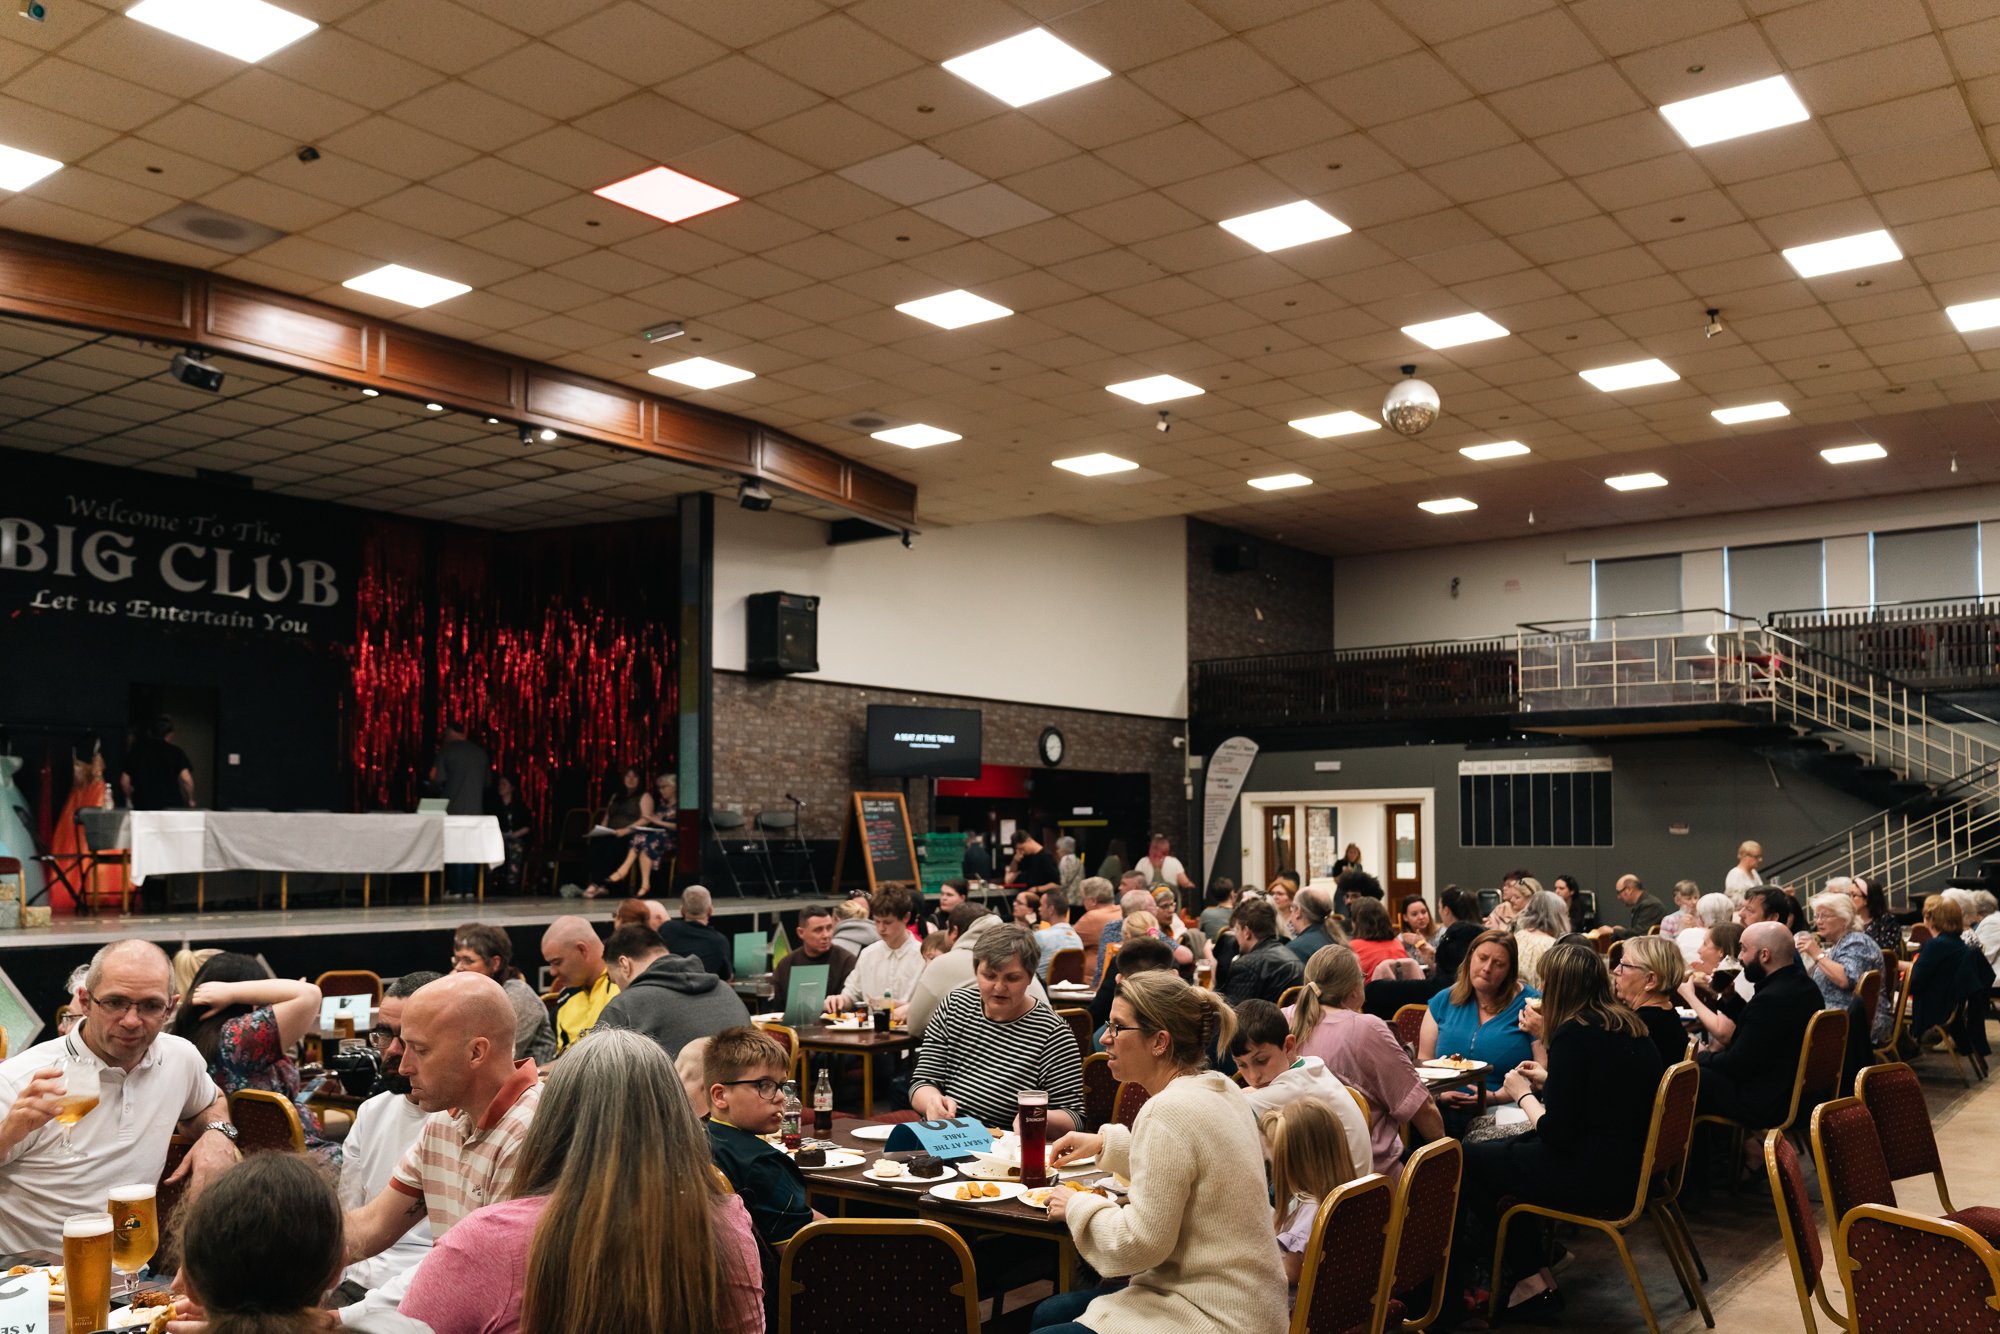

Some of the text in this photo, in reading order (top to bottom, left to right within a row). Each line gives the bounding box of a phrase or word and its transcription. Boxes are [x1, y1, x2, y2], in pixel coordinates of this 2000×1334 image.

[66, 495, 281, 546] Welcome To The
[0, 517, 339, 607] BIG CLUB
[30, 590, 310, 634] Let us Entertain You
[943, 1132, 967, 1140] TABLE
[964, 1139, 983, 1147] SEAT
[26, 1322, 36, 1334] A
